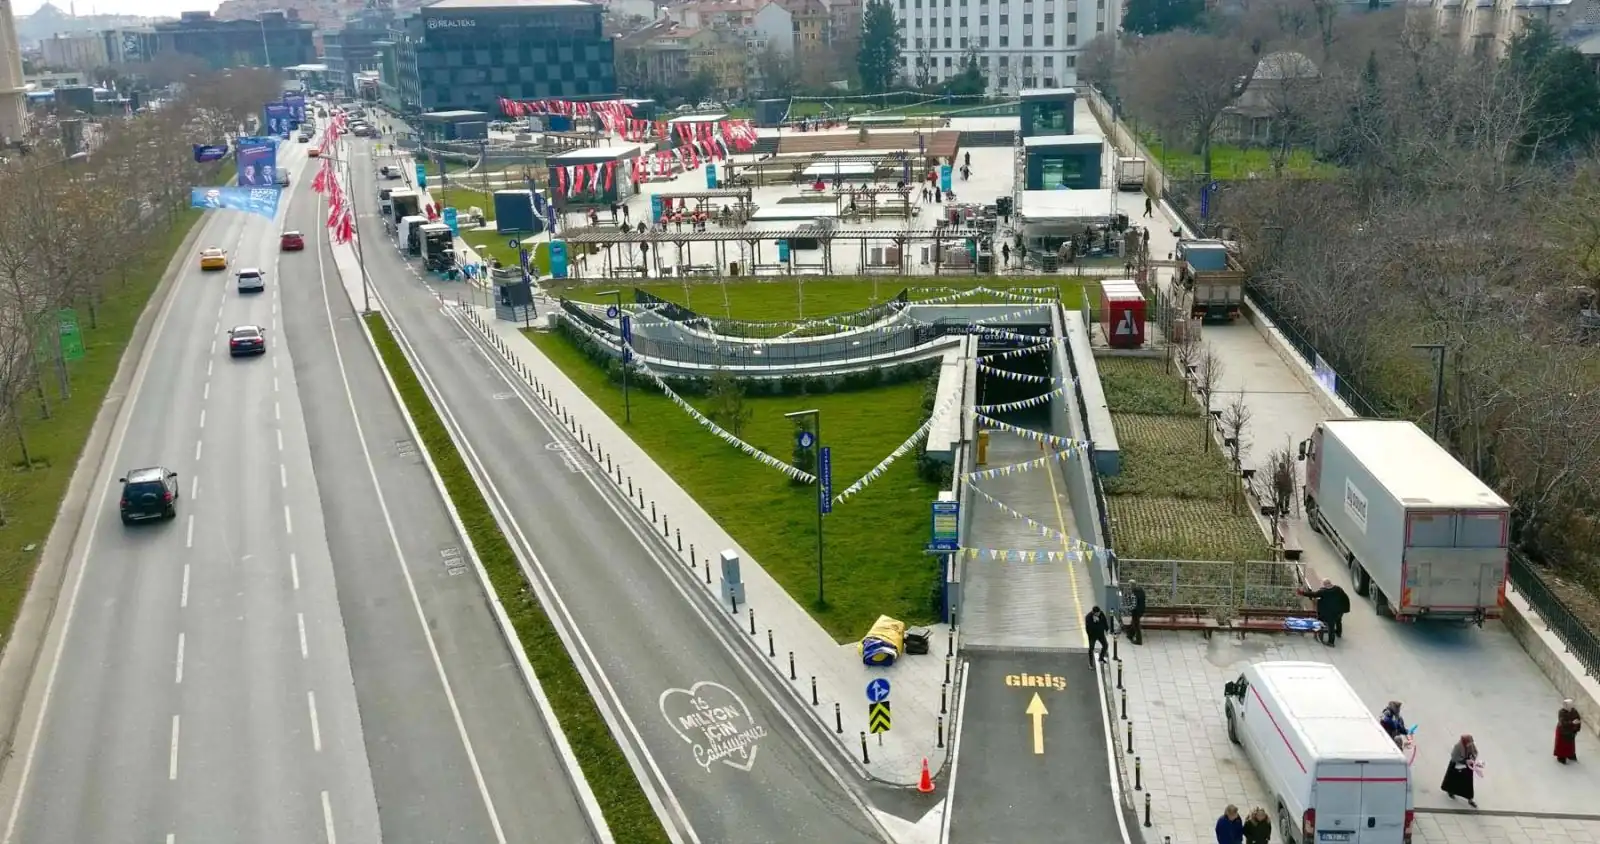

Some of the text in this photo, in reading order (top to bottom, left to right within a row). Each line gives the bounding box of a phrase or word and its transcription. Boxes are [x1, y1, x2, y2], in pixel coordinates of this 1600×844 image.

[438, 19, 476, 28] REALTEKS
[1005, 672, 1067, 691] GİRİŞ
[690, 697, 709, 711] 16
